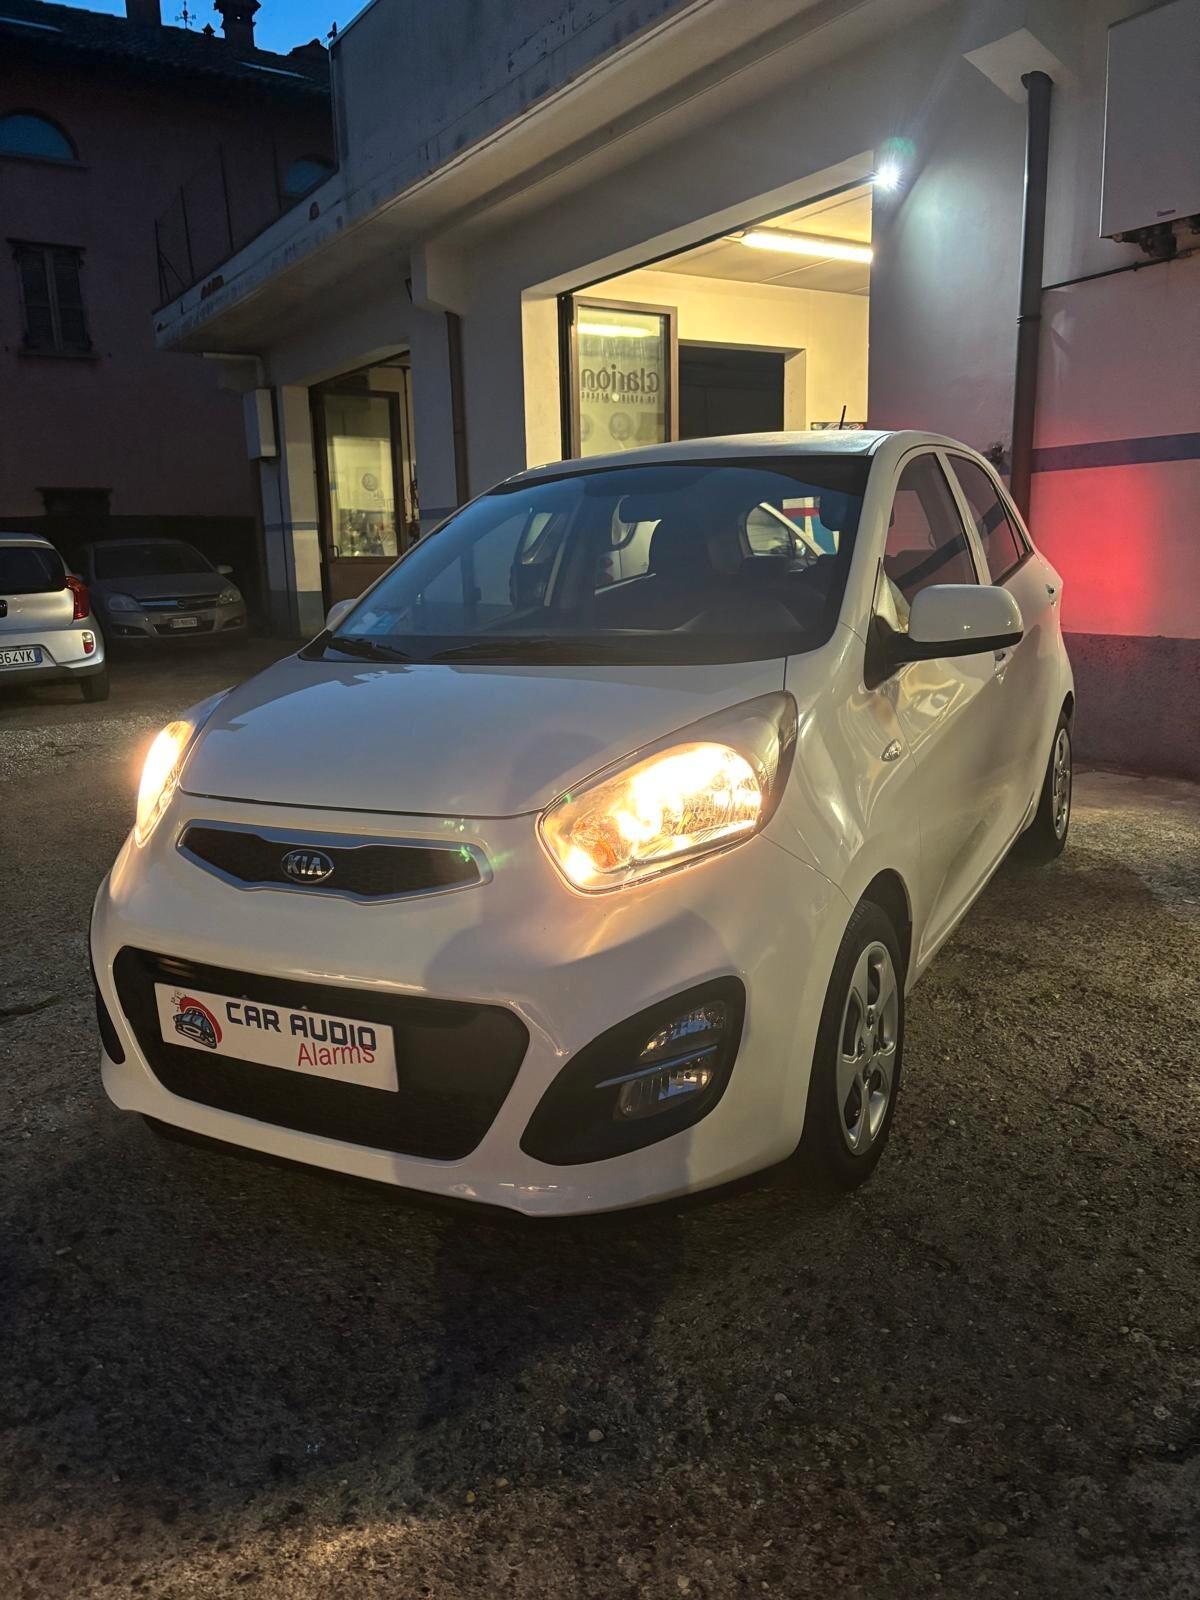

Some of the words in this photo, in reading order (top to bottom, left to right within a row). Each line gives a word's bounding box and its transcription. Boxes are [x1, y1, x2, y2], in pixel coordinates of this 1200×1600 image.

[287, 854, 323, 876] KIA
[225, 1001, 282, 1033] CAR
[289, 1013, 377, 1052] AUDIO
[297, 1041, 375, 1067] Alarms
